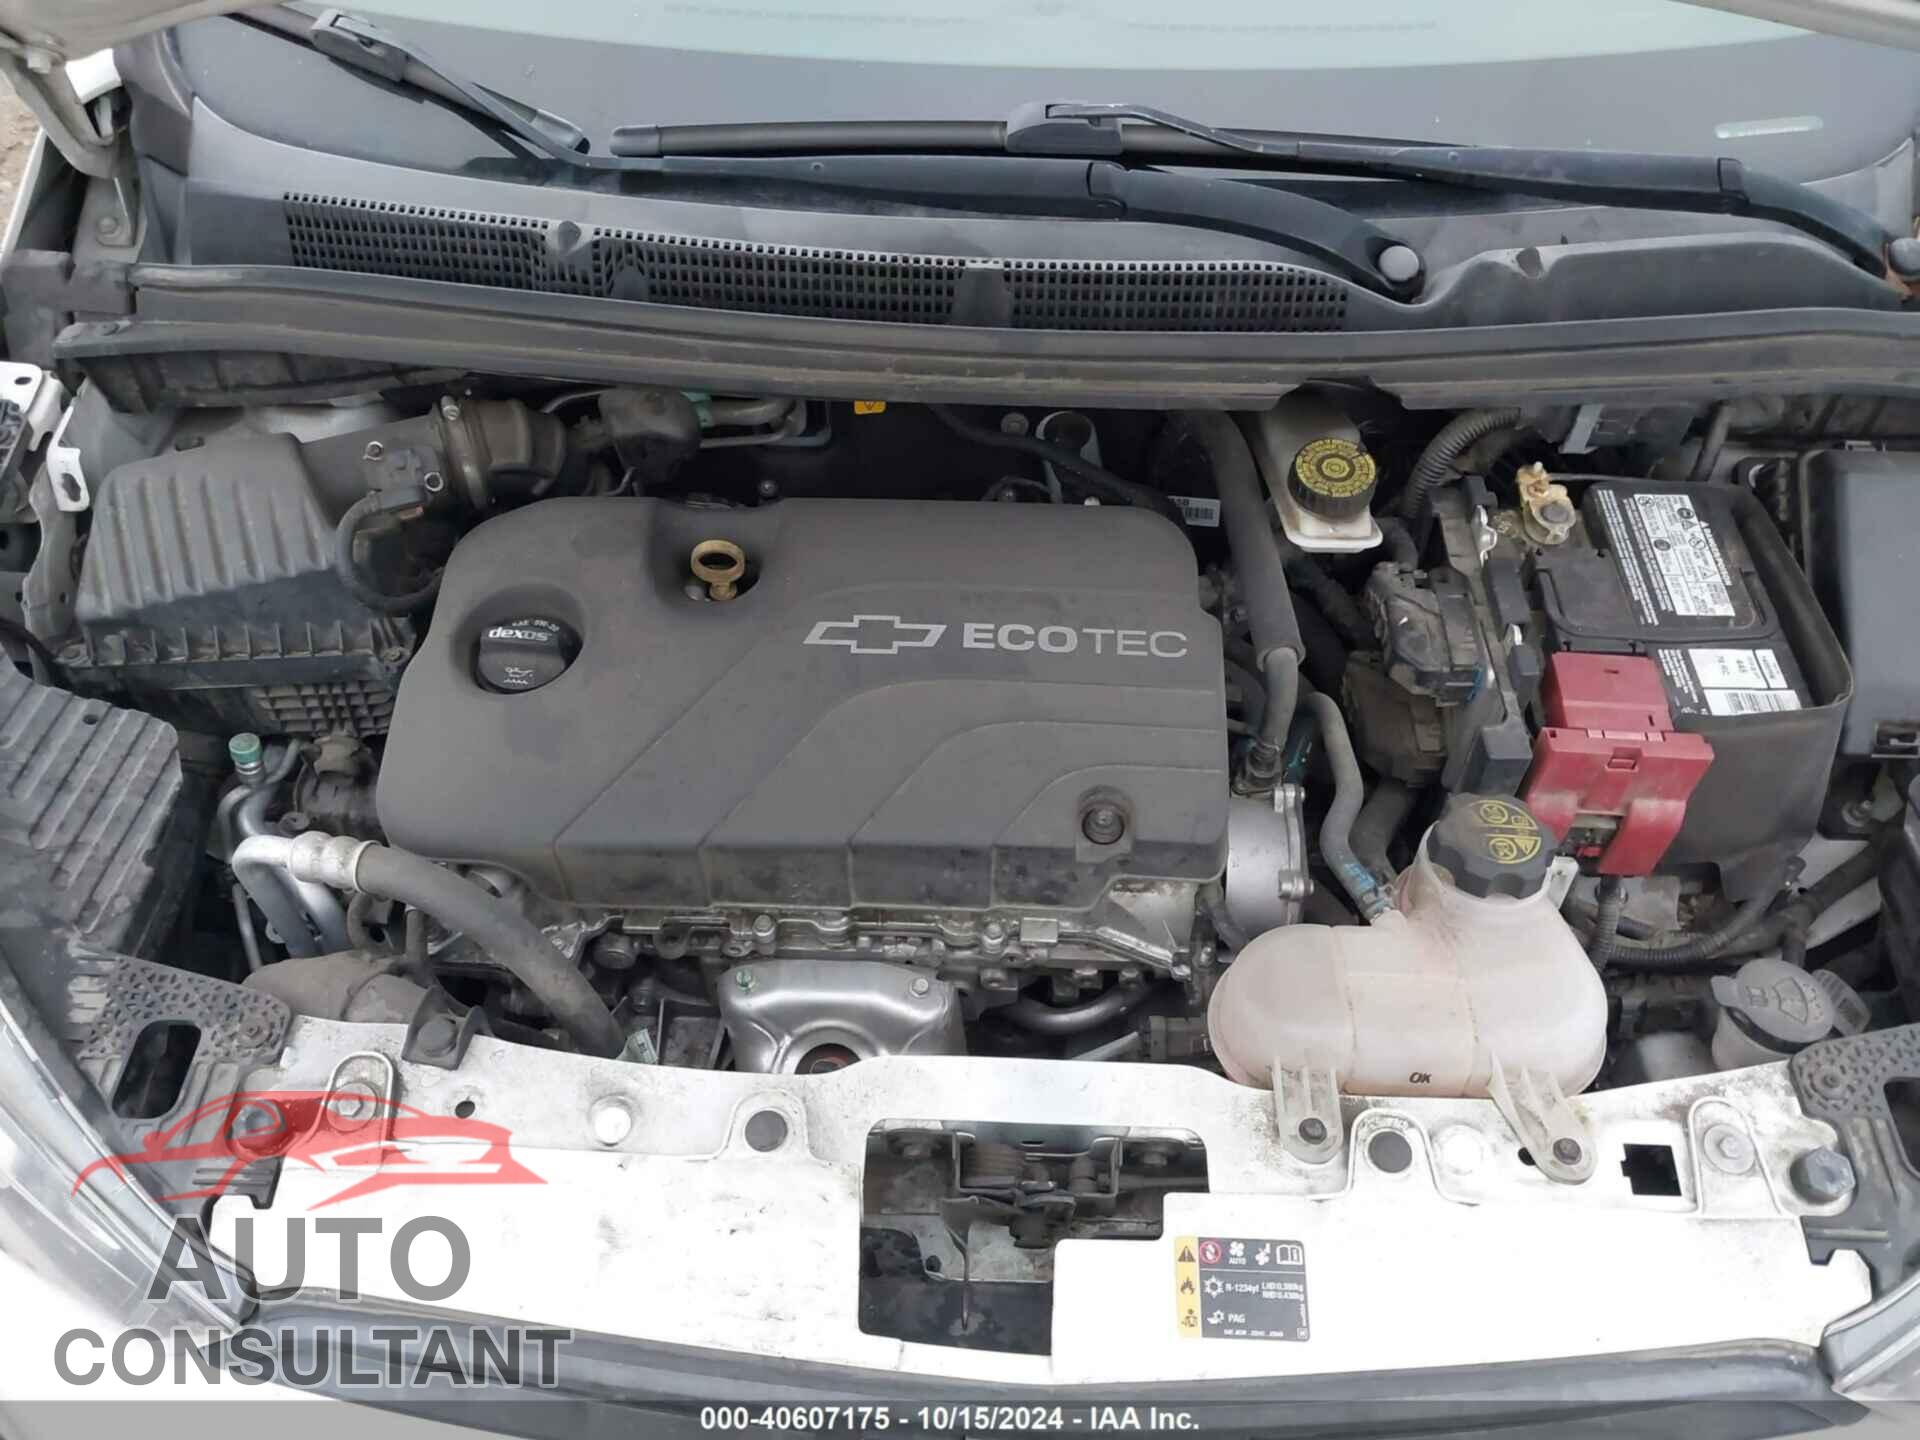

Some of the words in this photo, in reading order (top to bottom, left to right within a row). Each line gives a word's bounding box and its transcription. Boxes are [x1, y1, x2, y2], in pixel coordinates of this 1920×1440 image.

[488, 626, 548, 641] dexos
[962, 622, 1189, 659] ECOTEC
[1408, 1071, 1432, 1084] OK
[1228, 1314, 1246, 1323] PAG
